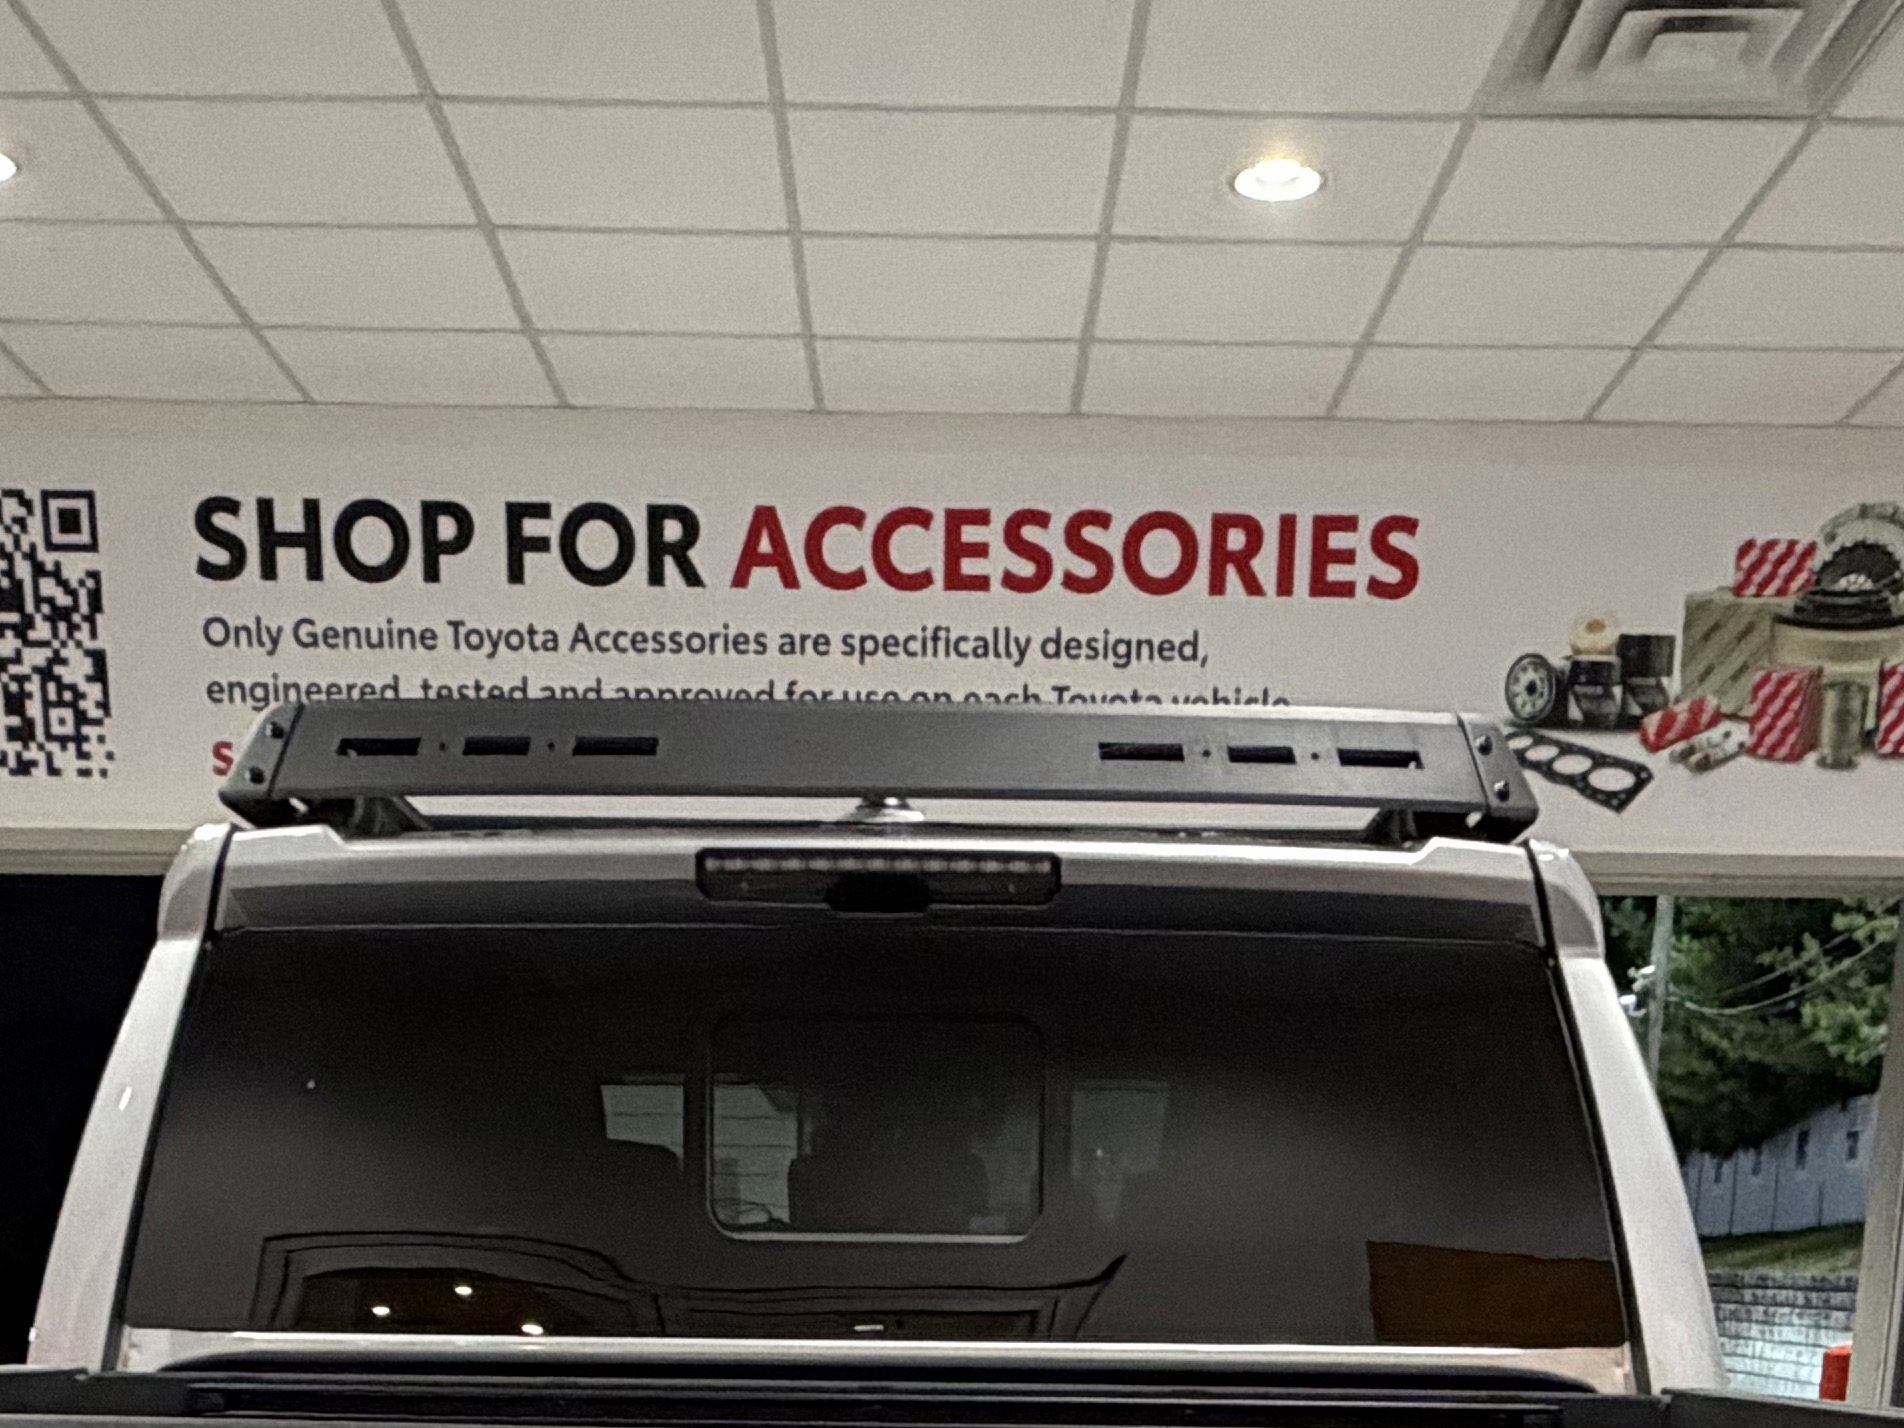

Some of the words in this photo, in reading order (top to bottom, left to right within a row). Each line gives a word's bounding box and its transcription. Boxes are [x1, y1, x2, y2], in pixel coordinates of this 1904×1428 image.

[194, 496, 475, 584] SHOP
[504, 501, 707, 588] FOR
[730, 504, 1421, 600] ACCESSORIES
[202, 615, 284, 657] Only
[292, 617, 439, 652] Genuine
[446, 620, 560, 659] Toyota
[568, 622, 768, 657] Accessories
[777, 630, 831, 657] are
[840, 625, 1032, 667] specifically
[1039, 628, 1210, 668] designed,
